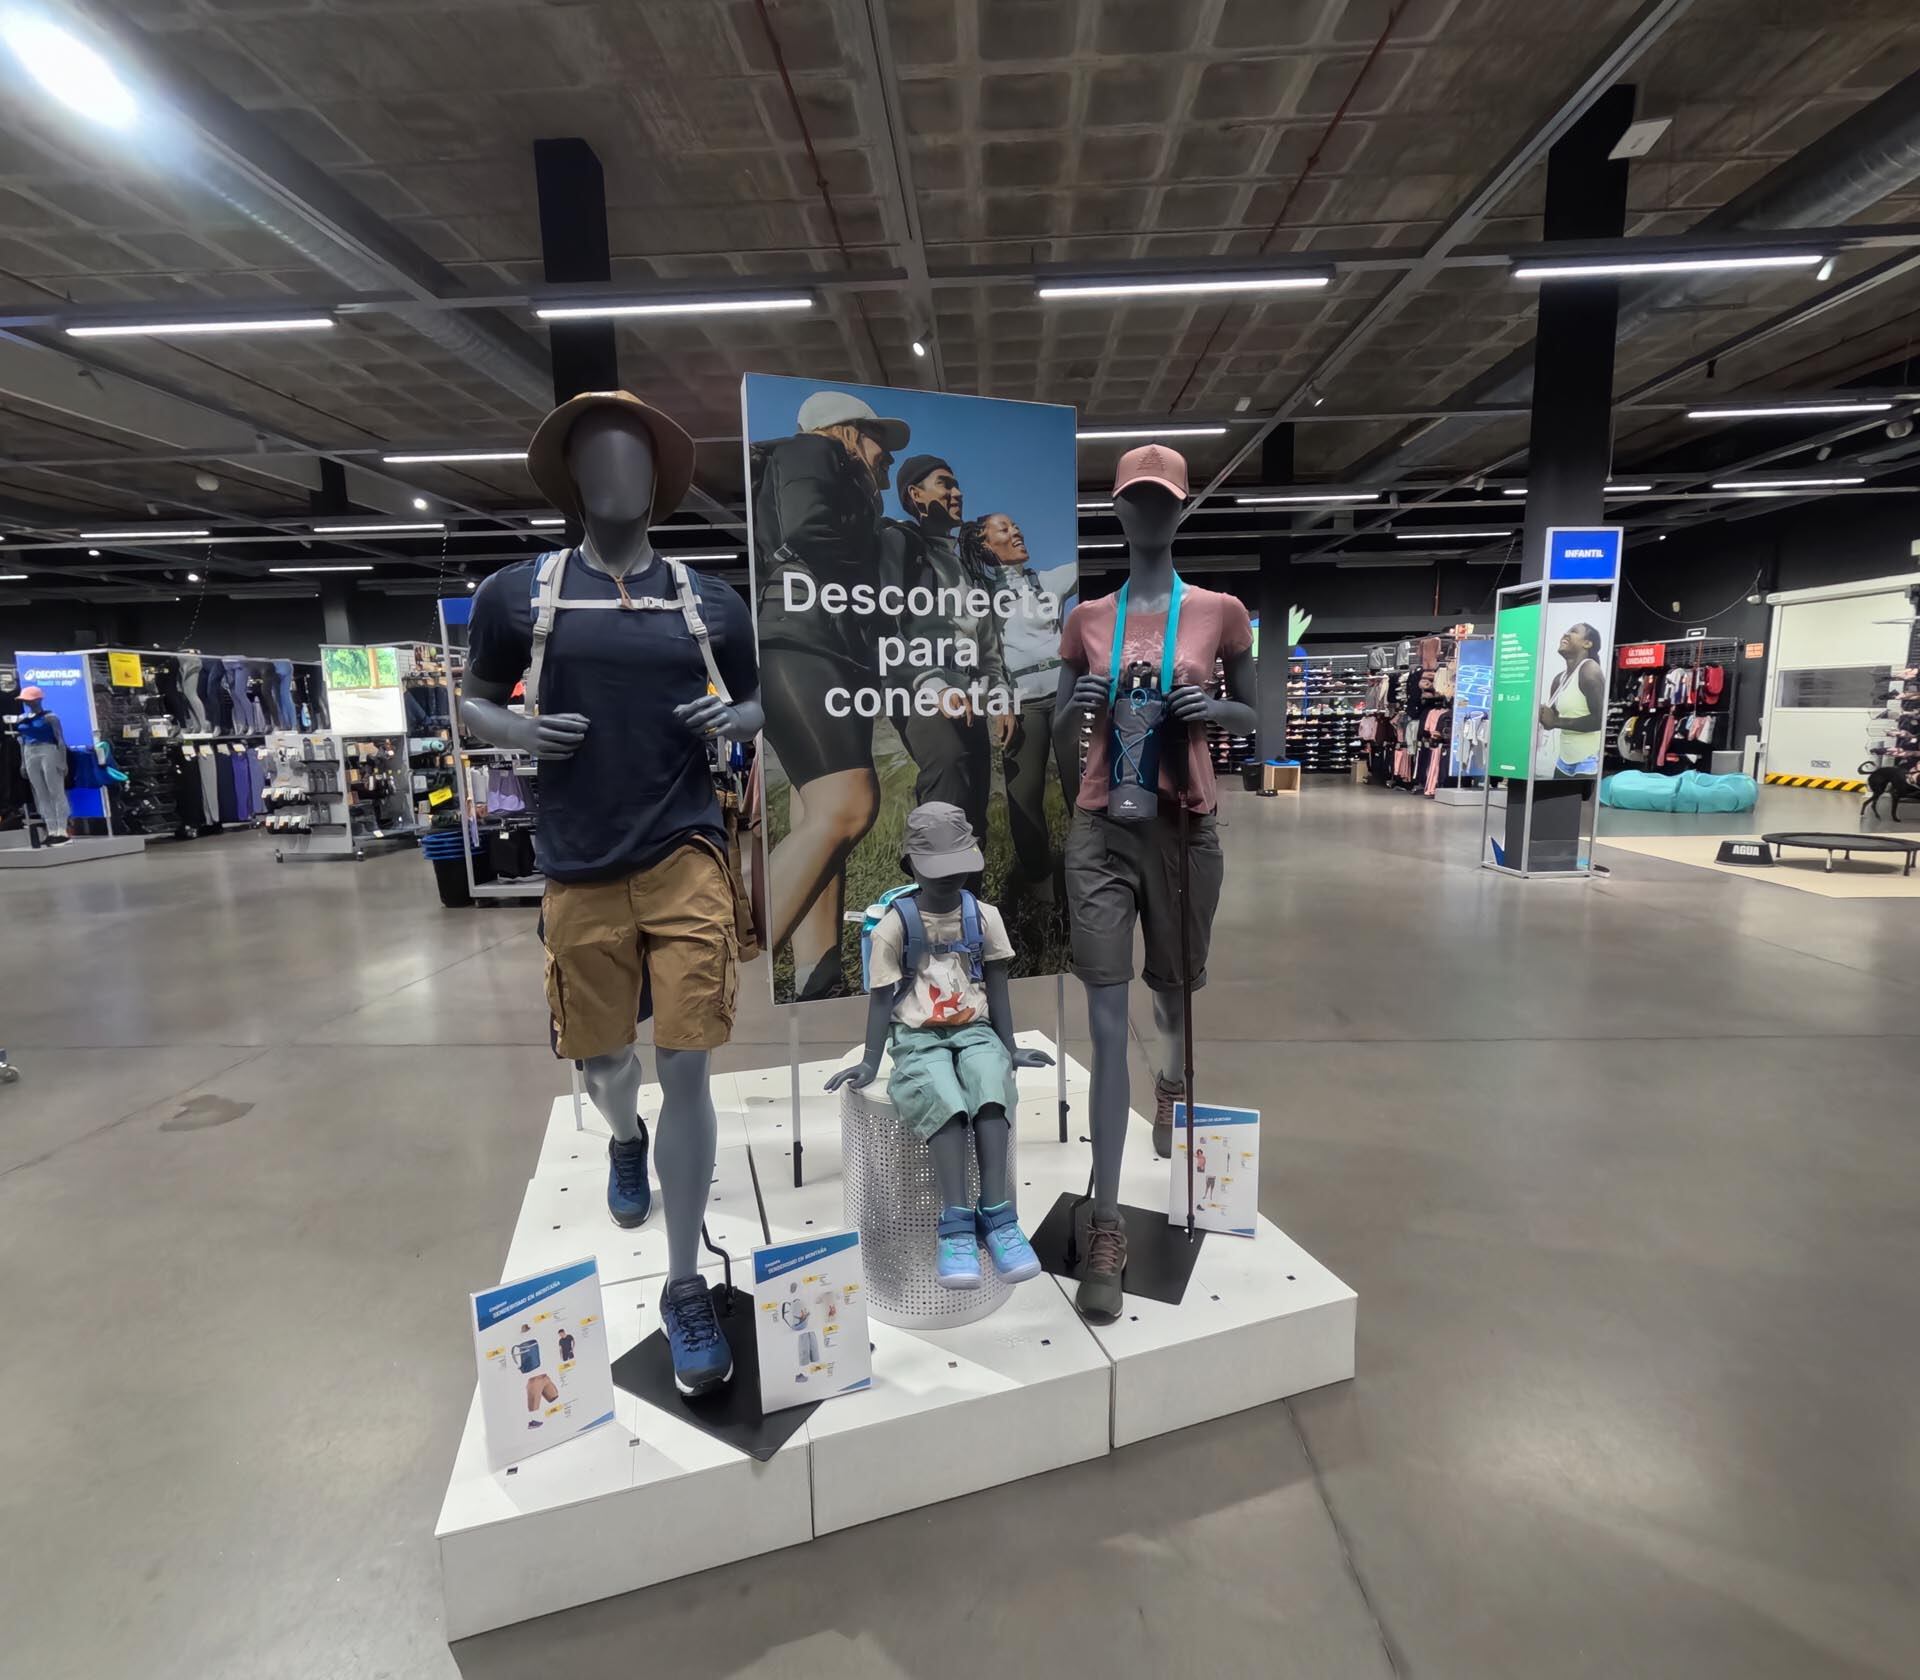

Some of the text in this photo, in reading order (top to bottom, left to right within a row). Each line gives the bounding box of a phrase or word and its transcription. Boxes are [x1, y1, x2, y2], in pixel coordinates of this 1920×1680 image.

[1564, 549, 1604, 558] INFANTIL
[782, 571, 1060, 620] Desconecta
[878, 635, 978, 676] para
[35, 669, 81, 679] DECATHLON
[824, 681, 1029, 717] conectar
[1732, 845, 1759, 857] AGUA
